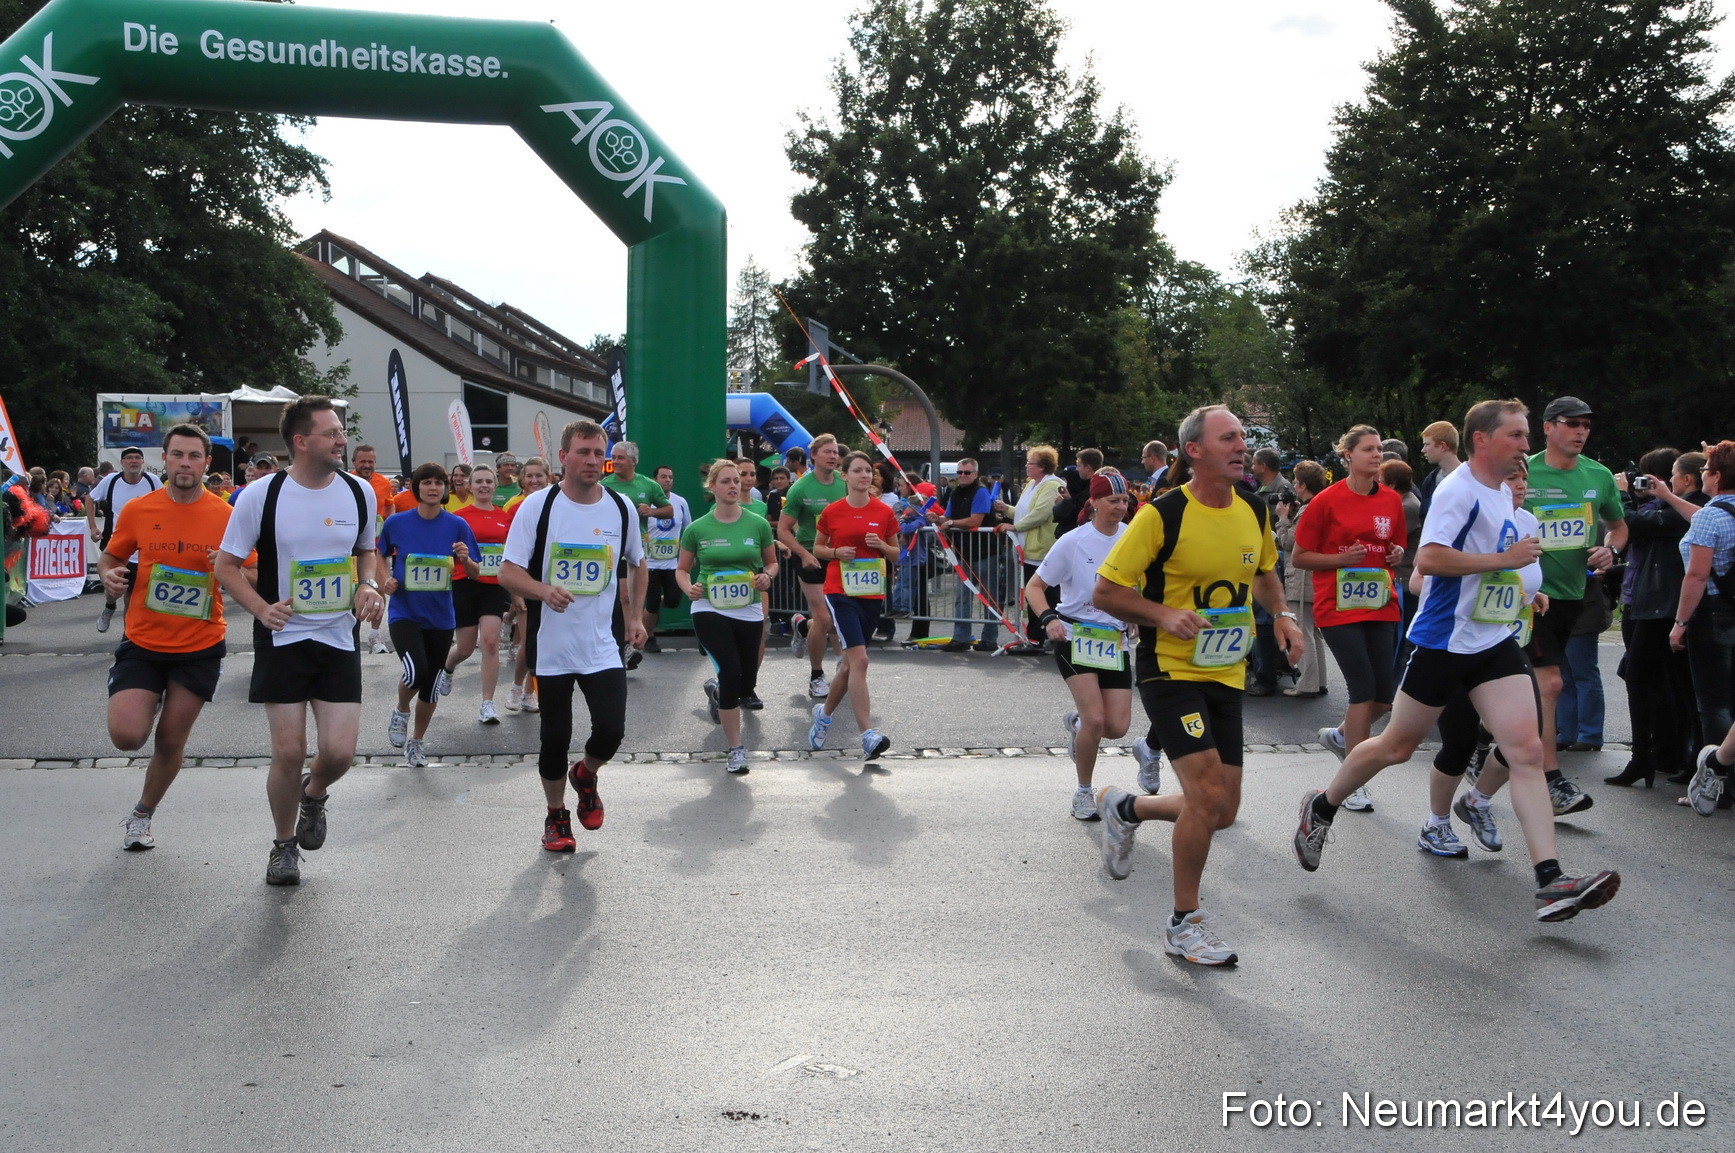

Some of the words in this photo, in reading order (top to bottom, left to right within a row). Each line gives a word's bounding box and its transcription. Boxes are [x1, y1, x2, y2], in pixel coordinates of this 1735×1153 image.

[123, 21, 179, 56] Die
[199, 29, 510, 79] Gesundheitskasse.
[0, 31, 101, 160] OK
[539, 100, 689, 224] AOK
[108, 413, 153, 428] TLA
[1538, 520, 1584, 539] 1192
[149, 542, 176, 551] EURO
[655, 545, 673, 555] 708
[34, 538, 80, 576] MEIER
[1242, 553, 1254, 564] FC
[411, 566, 441, 582] 111
[556, 560, 600, 582] 319
[844, 571, 879, 586] 1148
[154, 582, 201, 607] 622
[298, 576, 342, 601] 311
[710, 583, 749, 600] 1190
[1342, 581, 1379, 600] 948
[1483, 585, 1514, 610] 710
[1074, 638, 1116, 659] 1114
[1200, 627, 1243, 654] 772
[1186, 719, 1202, 732] FC
